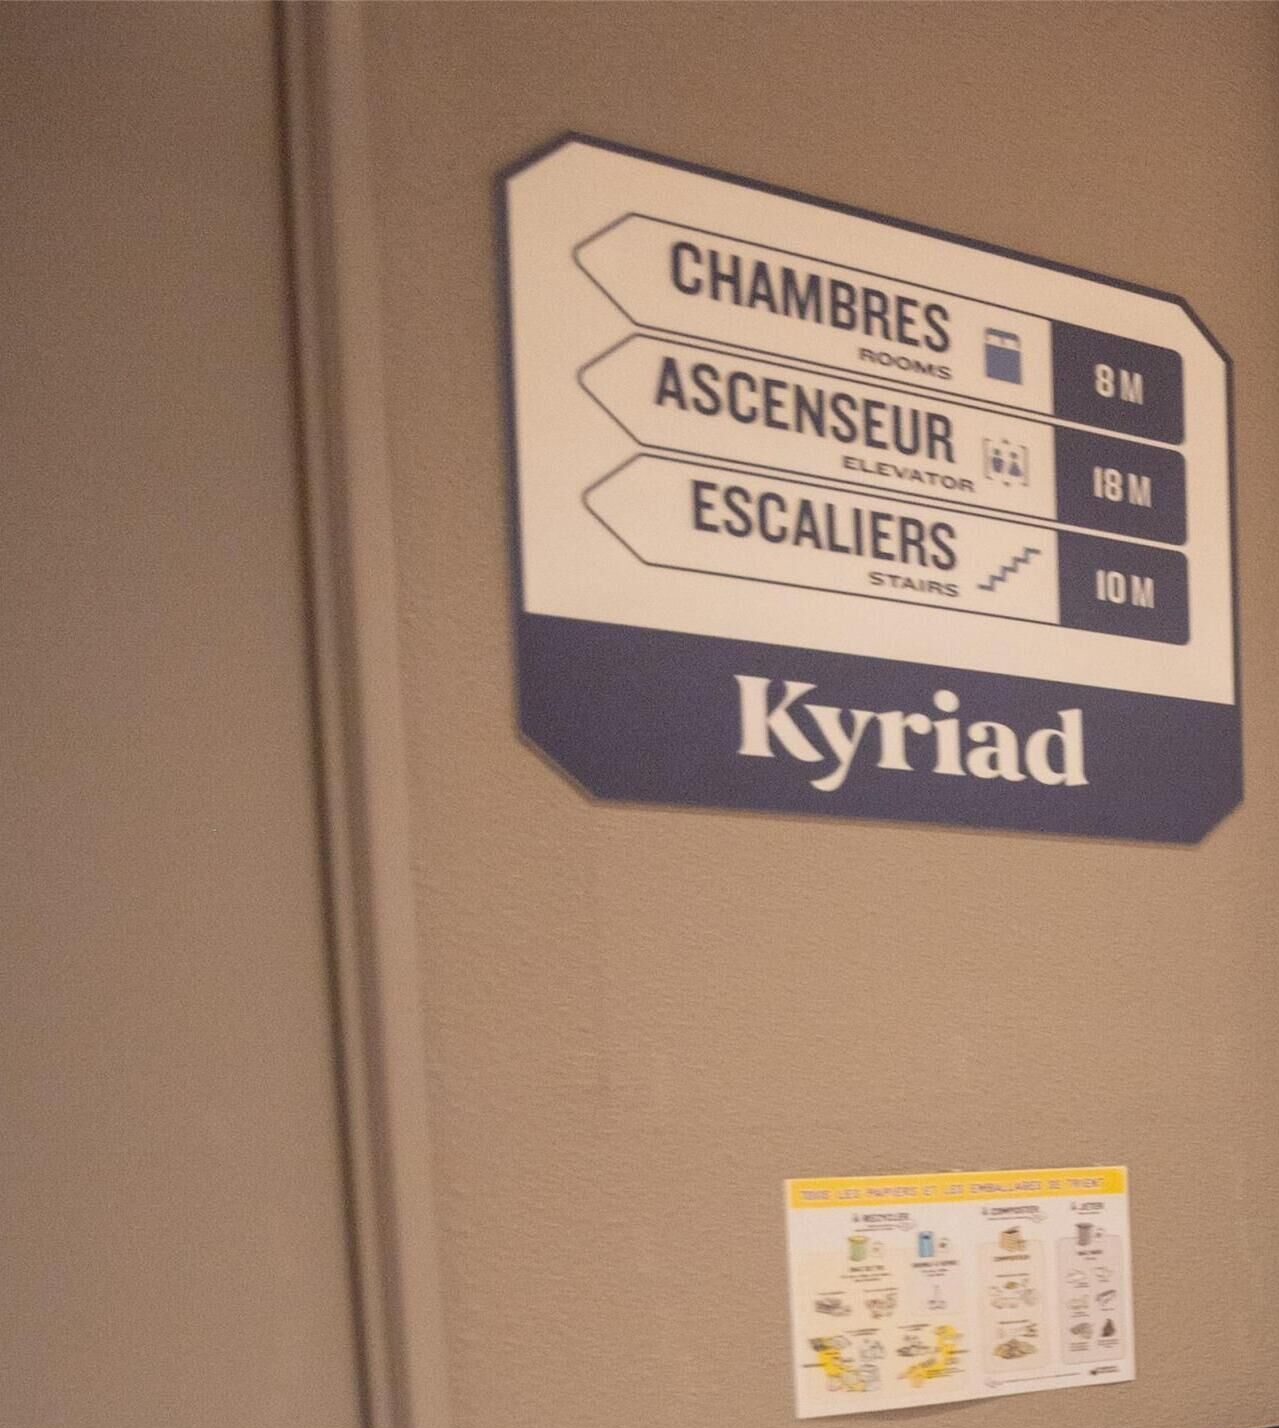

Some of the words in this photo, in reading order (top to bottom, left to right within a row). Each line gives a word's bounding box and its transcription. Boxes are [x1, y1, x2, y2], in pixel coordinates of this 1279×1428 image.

[670, 240, 951, 353] CHAMBRES
[858, 347, 953, 381] ROOMS
[1094, 363, 1115, 399] 8
[1119, 368, 1144, 406] M
[655, 355, 955, 464] ASCENSEUR
[841, 455, 976, 493] ELEVATOR
[1093, 465, 1124, 502] 18
[1127, 472, 1152, 509] M
[690, 479, 958, 571] ESCALIERS
[868, 571, 960, 598] STAIRS
[1095, 569, 1127, 604] 10
[1130, 574, 1155, 609] M
[733, 673, 1090, 793] Kyriad
